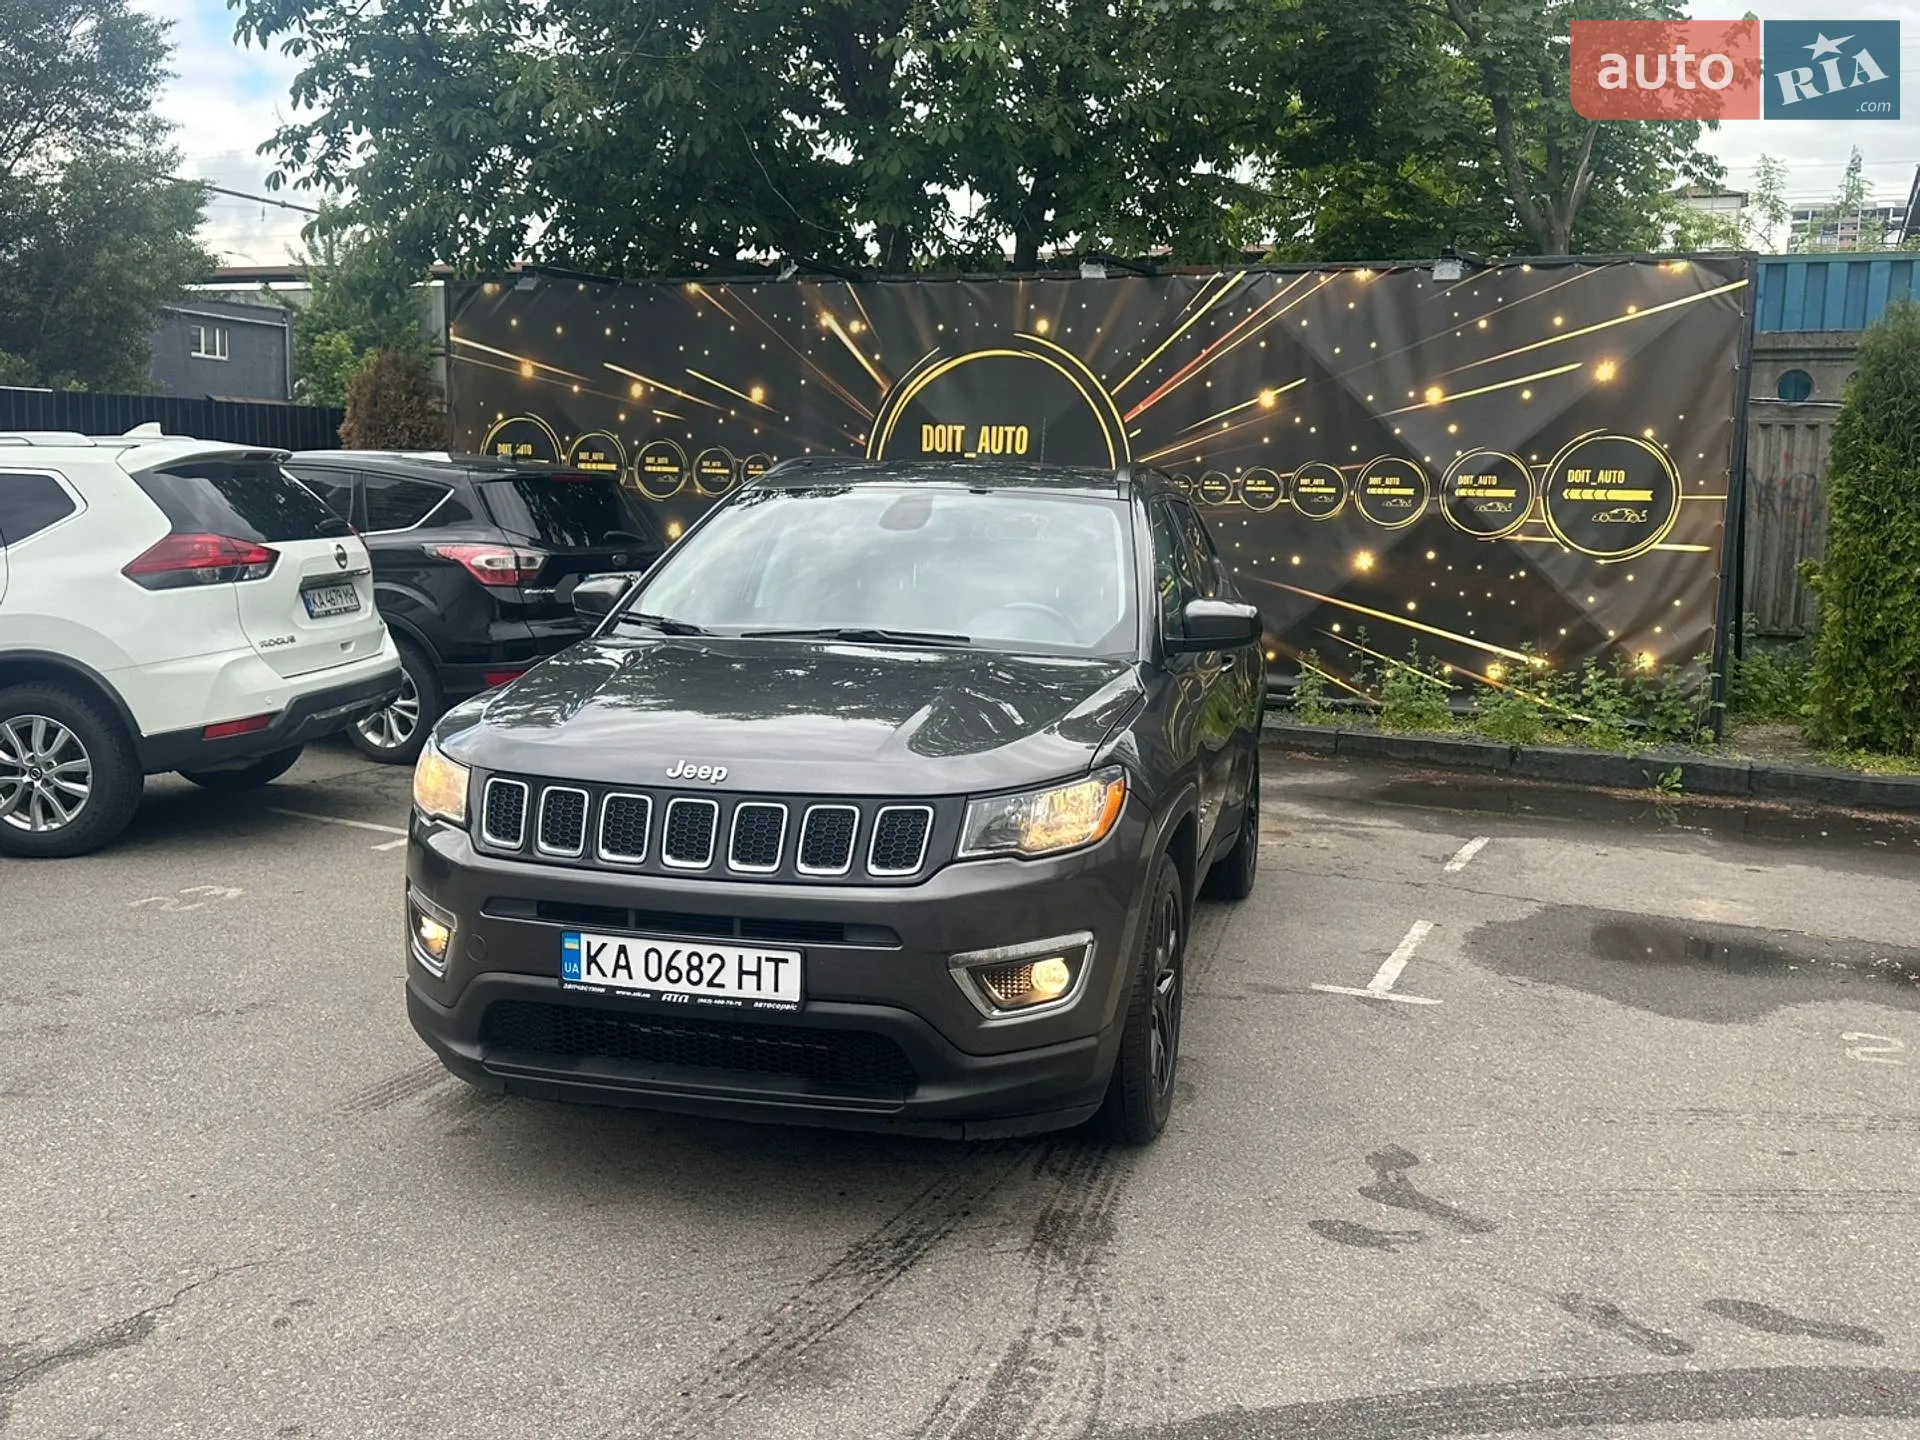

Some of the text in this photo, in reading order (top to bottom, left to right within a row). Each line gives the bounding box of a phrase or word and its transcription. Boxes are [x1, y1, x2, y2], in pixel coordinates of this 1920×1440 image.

[921, 424, 1029, 458] DOIT_AUTO
[1567, 469, 1625, 486] DOIT_AUTO
[665, 759, 728, 785] Jeep
[564, 962, 579, 974] UA
[586, 940, 789, 993] KA 0682 HT
